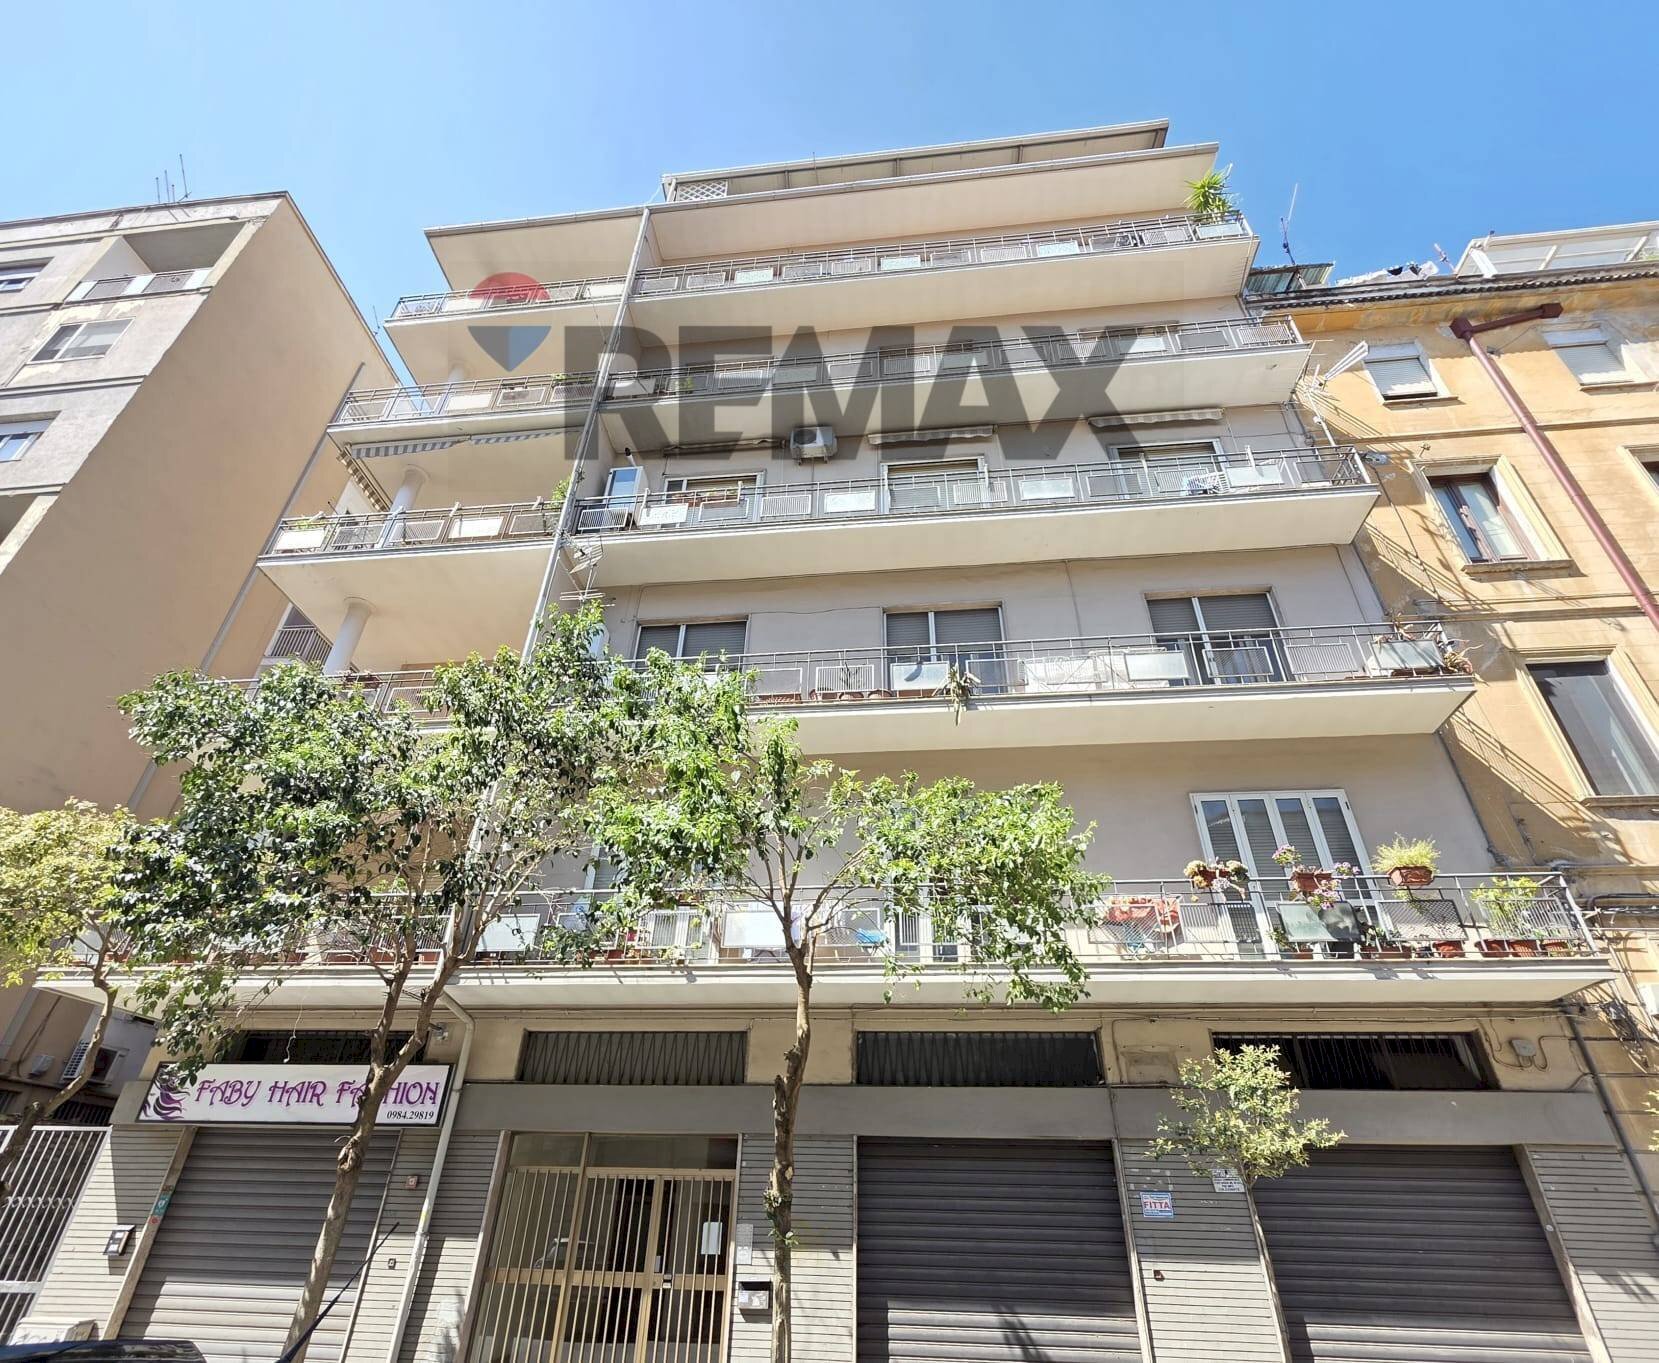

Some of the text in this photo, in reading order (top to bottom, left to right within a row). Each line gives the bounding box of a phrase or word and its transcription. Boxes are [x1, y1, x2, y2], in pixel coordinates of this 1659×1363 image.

[194, 1079, 440, 1107] FABY HAIR FAHION
[386, 1110, 434, 1120] 0984.29819
[1143, 1201, 1170, 1209] FITTA
